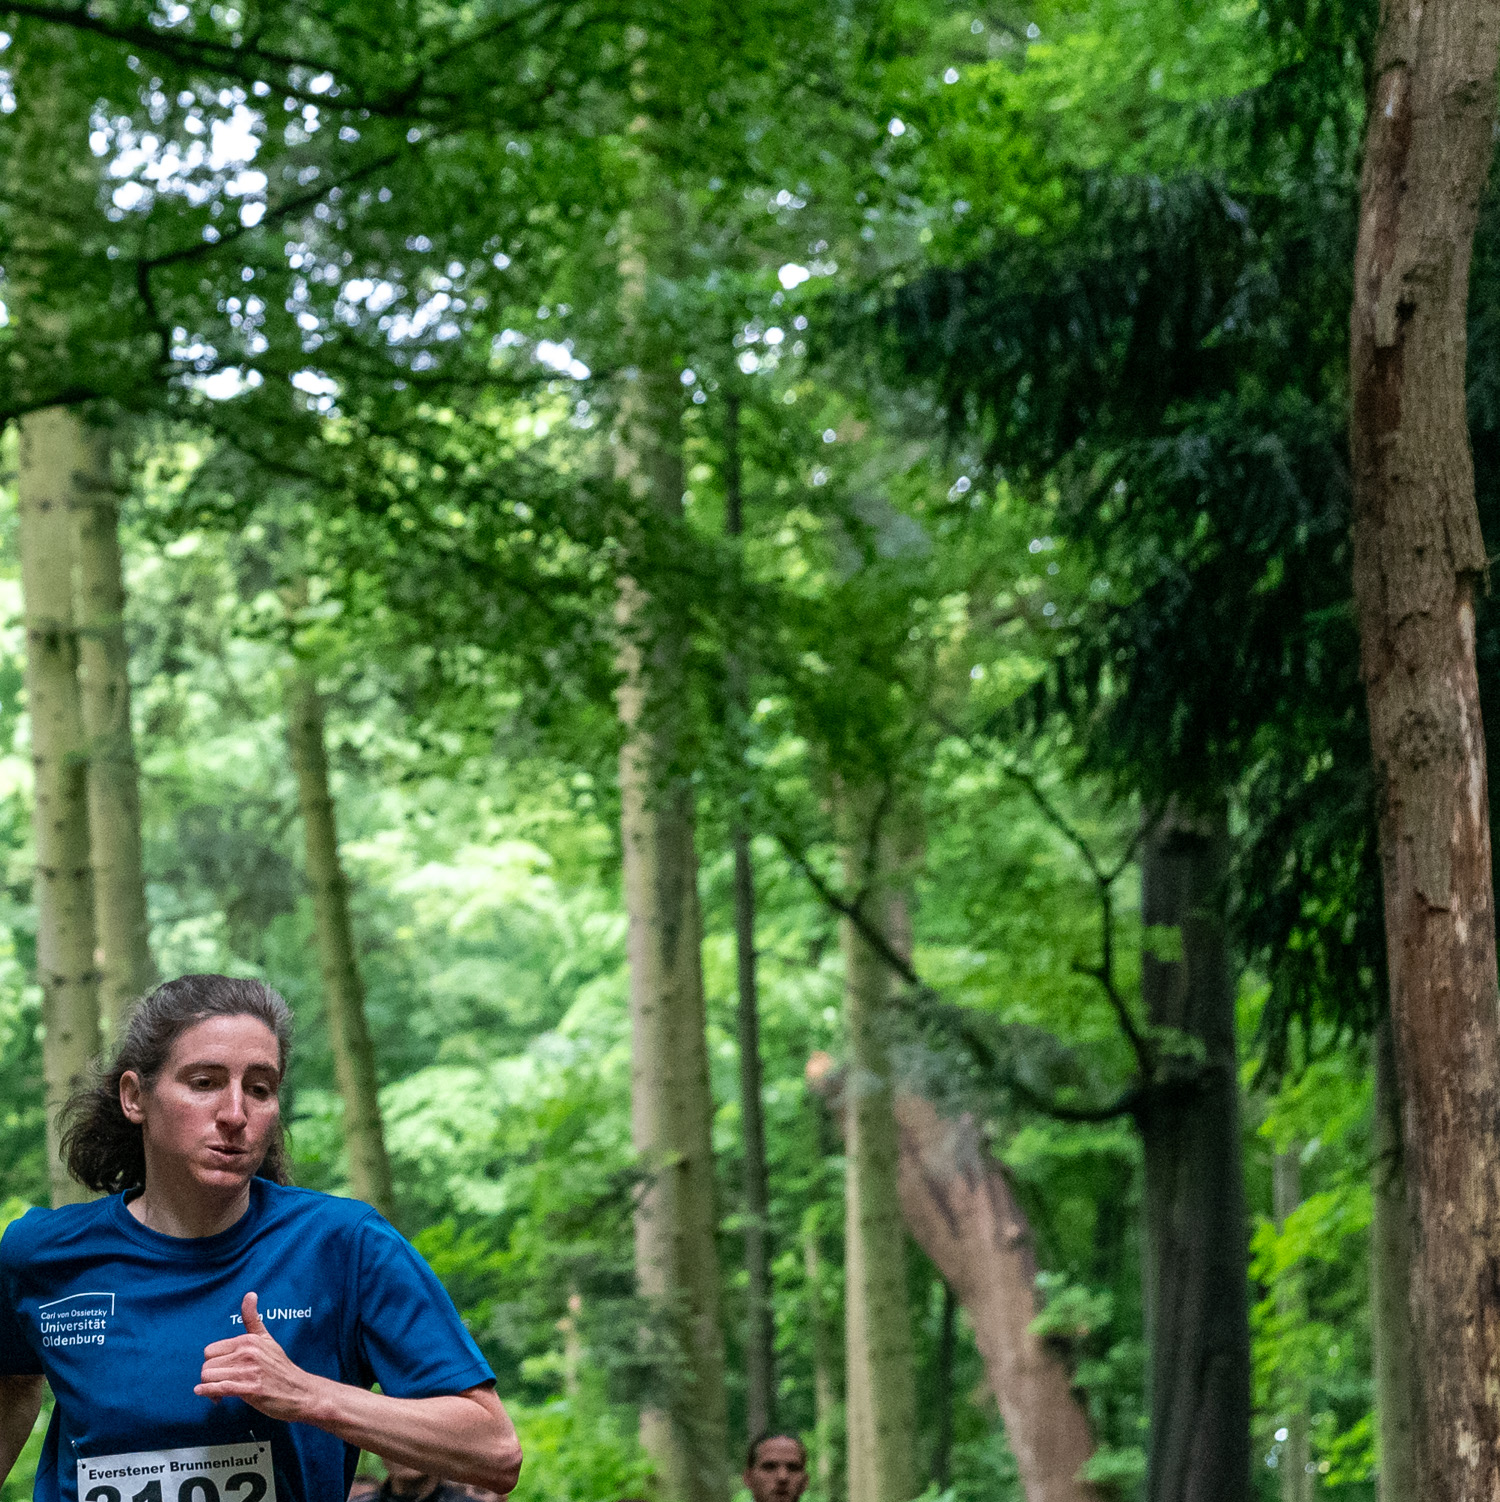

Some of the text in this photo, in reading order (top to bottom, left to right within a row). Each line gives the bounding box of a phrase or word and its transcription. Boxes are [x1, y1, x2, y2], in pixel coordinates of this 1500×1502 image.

[40, 1308, 107, 1320] Carl von Ossietzky
[229, 1306, 312, 1325] Te UNIted
[40, 1318, 107, 1333] Universität
[42, 1333, 105, 1347] Oldenburg
[88, 1453, 259, 1481] Everstener Brunnenlauf
